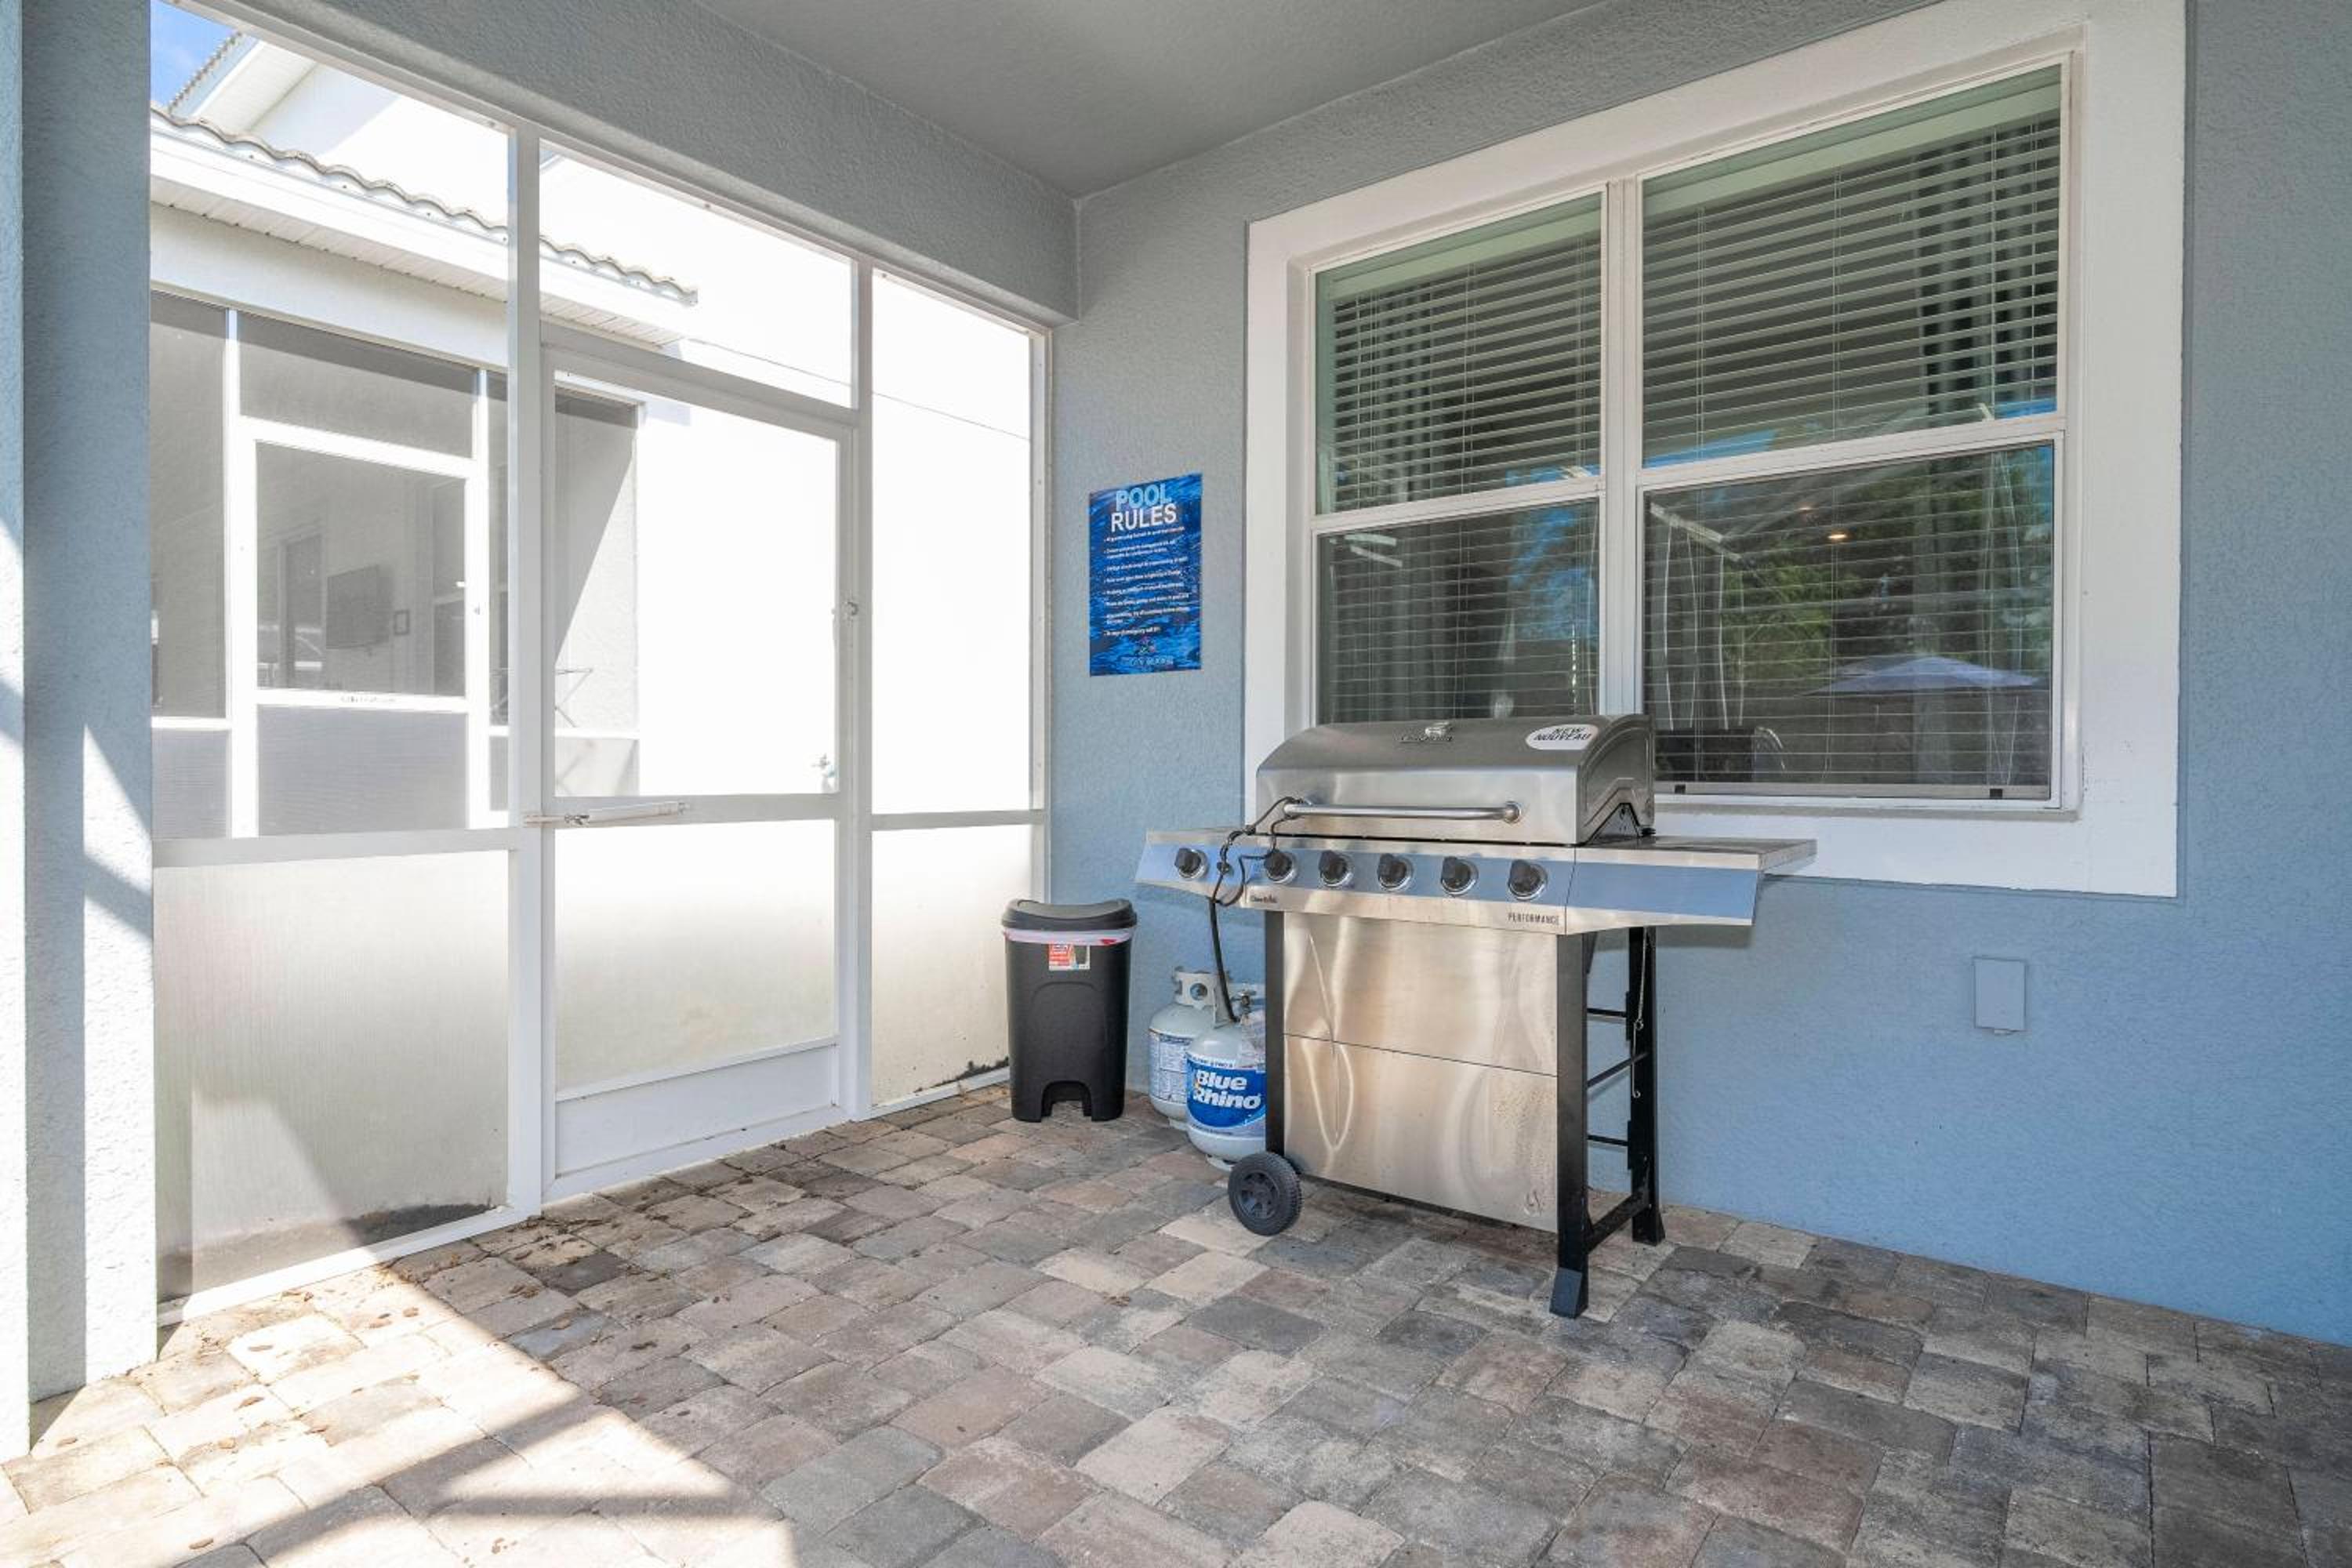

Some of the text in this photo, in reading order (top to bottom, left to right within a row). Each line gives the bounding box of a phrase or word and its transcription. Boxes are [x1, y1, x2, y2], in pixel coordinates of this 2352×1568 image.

[1116, 484, 1172, 511] POOL
[1111, 503, 1177, 532] RULES
[1508, 913, 1559, 925] PERFORMANCE
[1196, 1069, 1247, 1091] Blue
[1193, 1087, 1261, 1109] Rhino
